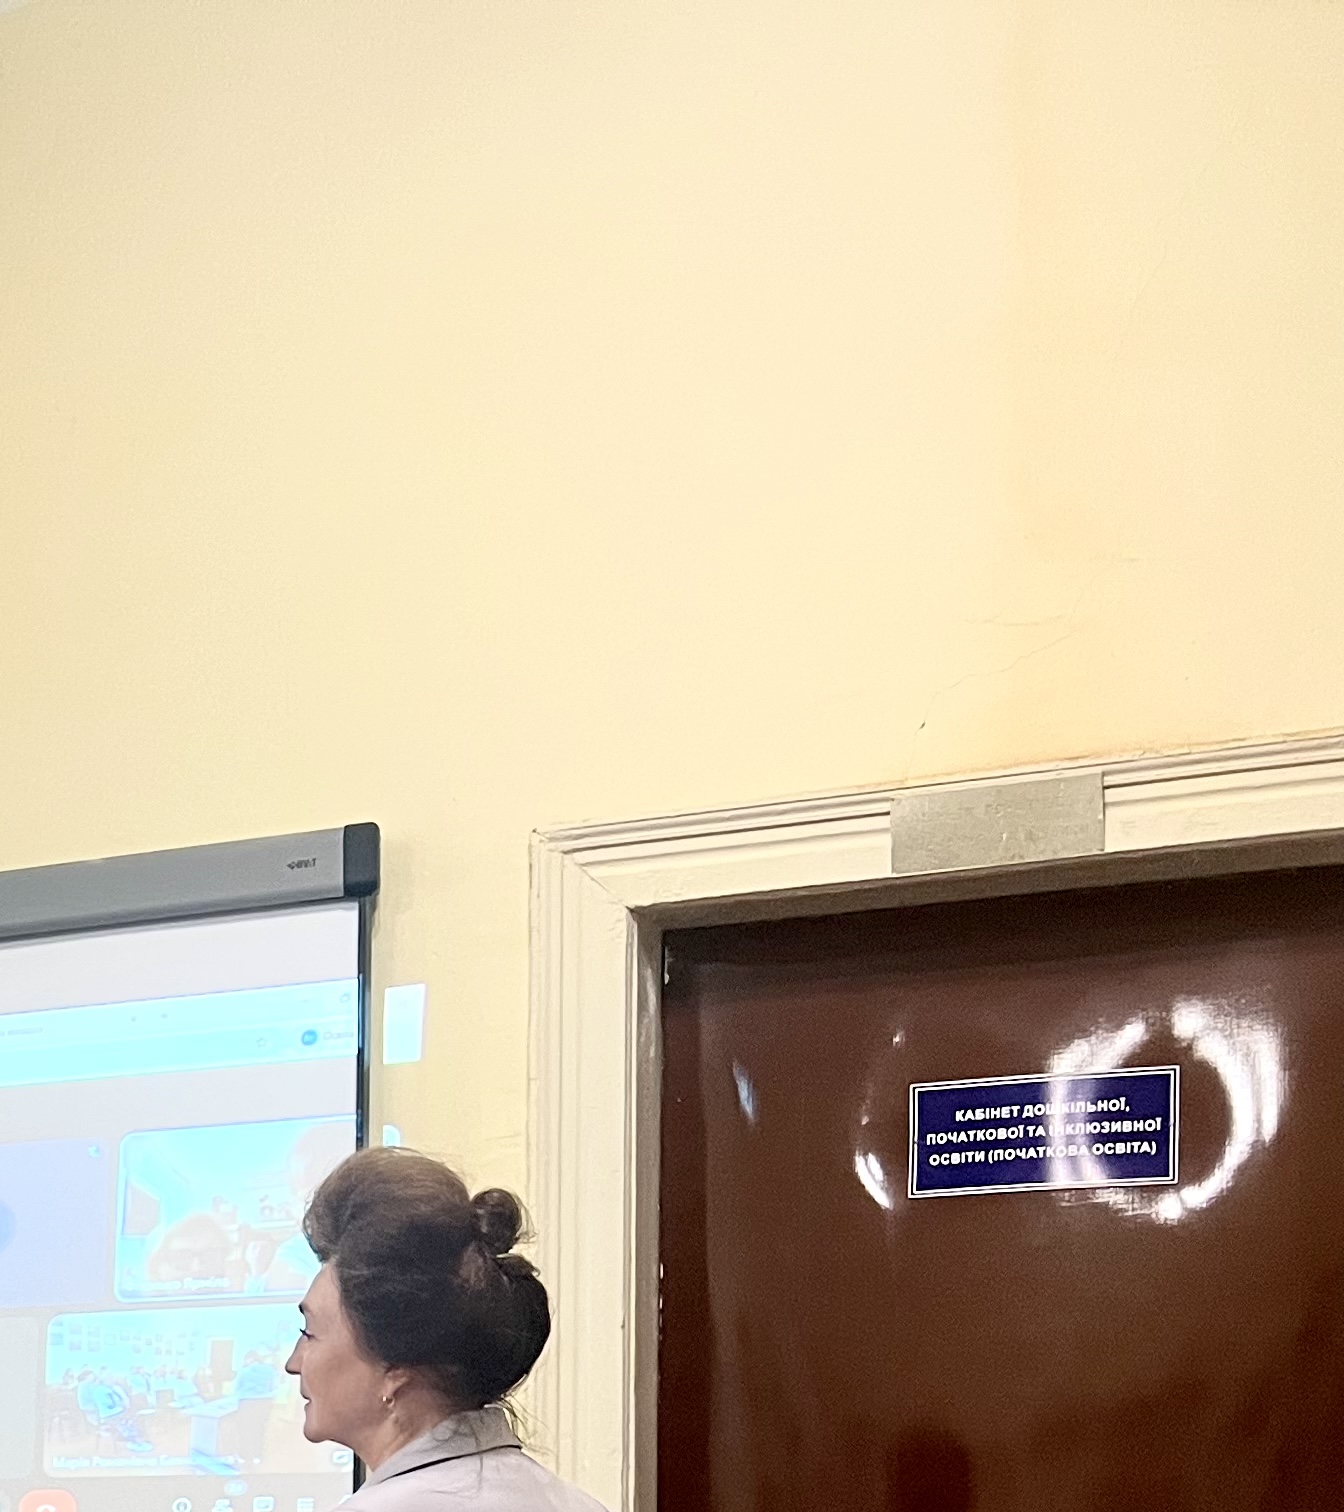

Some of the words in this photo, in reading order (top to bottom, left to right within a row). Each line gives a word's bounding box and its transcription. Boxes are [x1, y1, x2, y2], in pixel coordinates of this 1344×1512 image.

[955, 1105, 1021, 1122] КАБІНЕТ
[1022, 1096, 1130, 1118] ДОШКІЛЬНОЇ,
[926, 1124, 1025, 1146] ПОЧАТКОВОЇ
[1026, 1124, 1046, 1138] ТА
[1048, 1116, 1162, 1137] ІНКЛЮЗИВНОЇ
[928, 1150, 985, 1166] ОСВІТИ
[988, 1144, 1090, 1164] (ПОЧАТКОВА
[1092, 1140, 1157, 1156] ОСВІТА)
